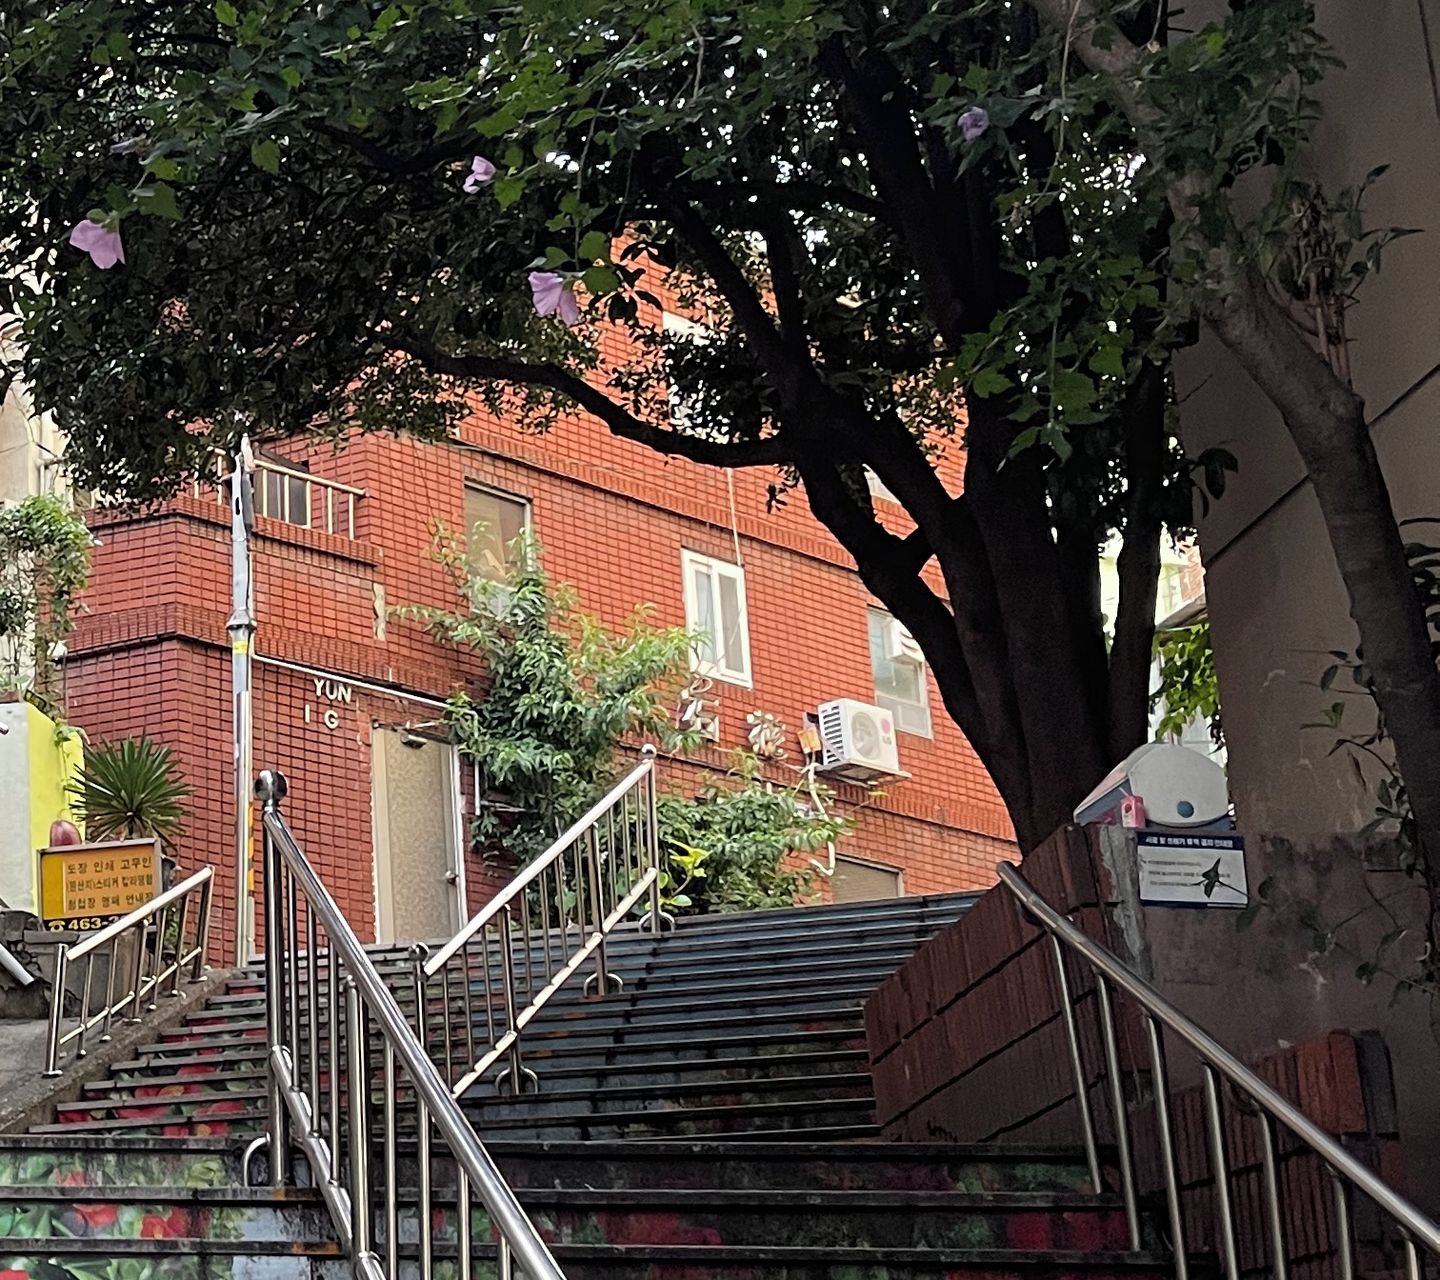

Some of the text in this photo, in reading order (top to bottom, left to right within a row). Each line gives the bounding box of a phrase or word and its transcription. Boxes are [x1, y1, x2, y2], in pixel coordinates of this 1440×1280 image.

[313, 678, 352, 704] YUN
[67, 856, 152, 874] 도장 인쇄 고무인
